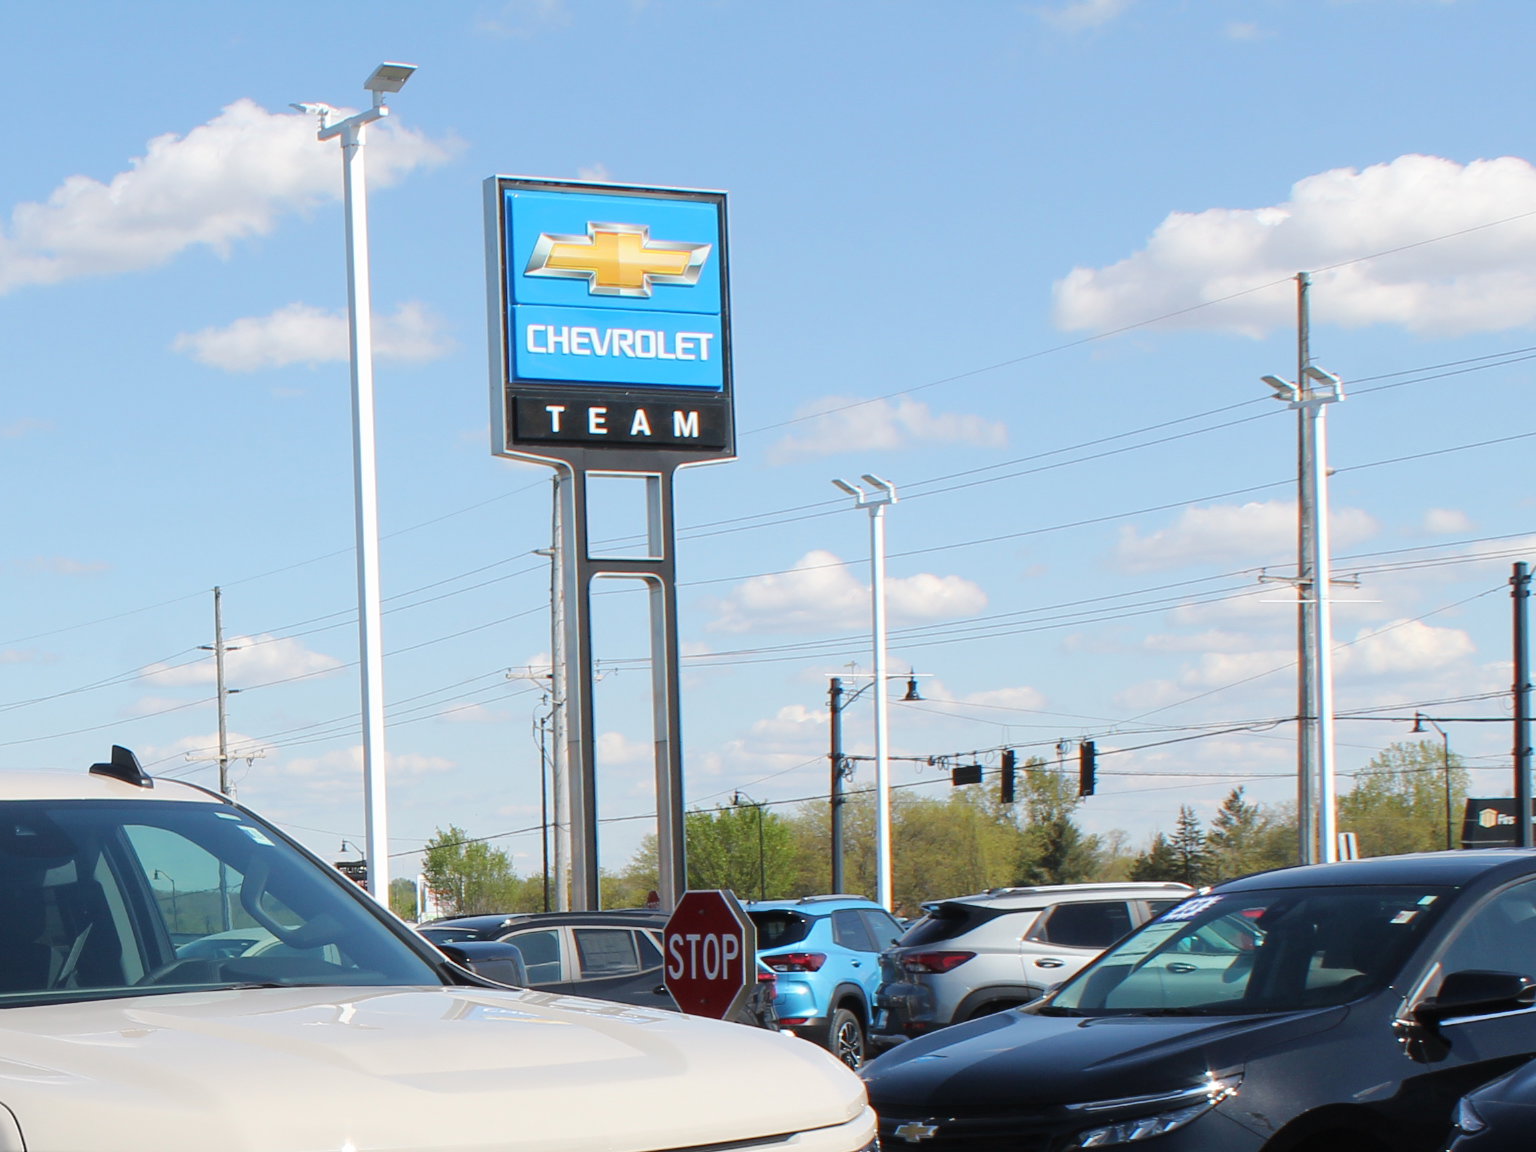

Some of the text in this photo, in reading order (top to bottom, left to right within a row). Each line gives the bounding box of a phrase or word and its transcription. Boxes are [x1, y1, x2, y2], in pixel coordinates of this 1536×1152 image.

[526, 324, 714, 361] CHEVROLET
[546, 405, 699, 438] TEAM
[668, 933, 739, 980] STOP
